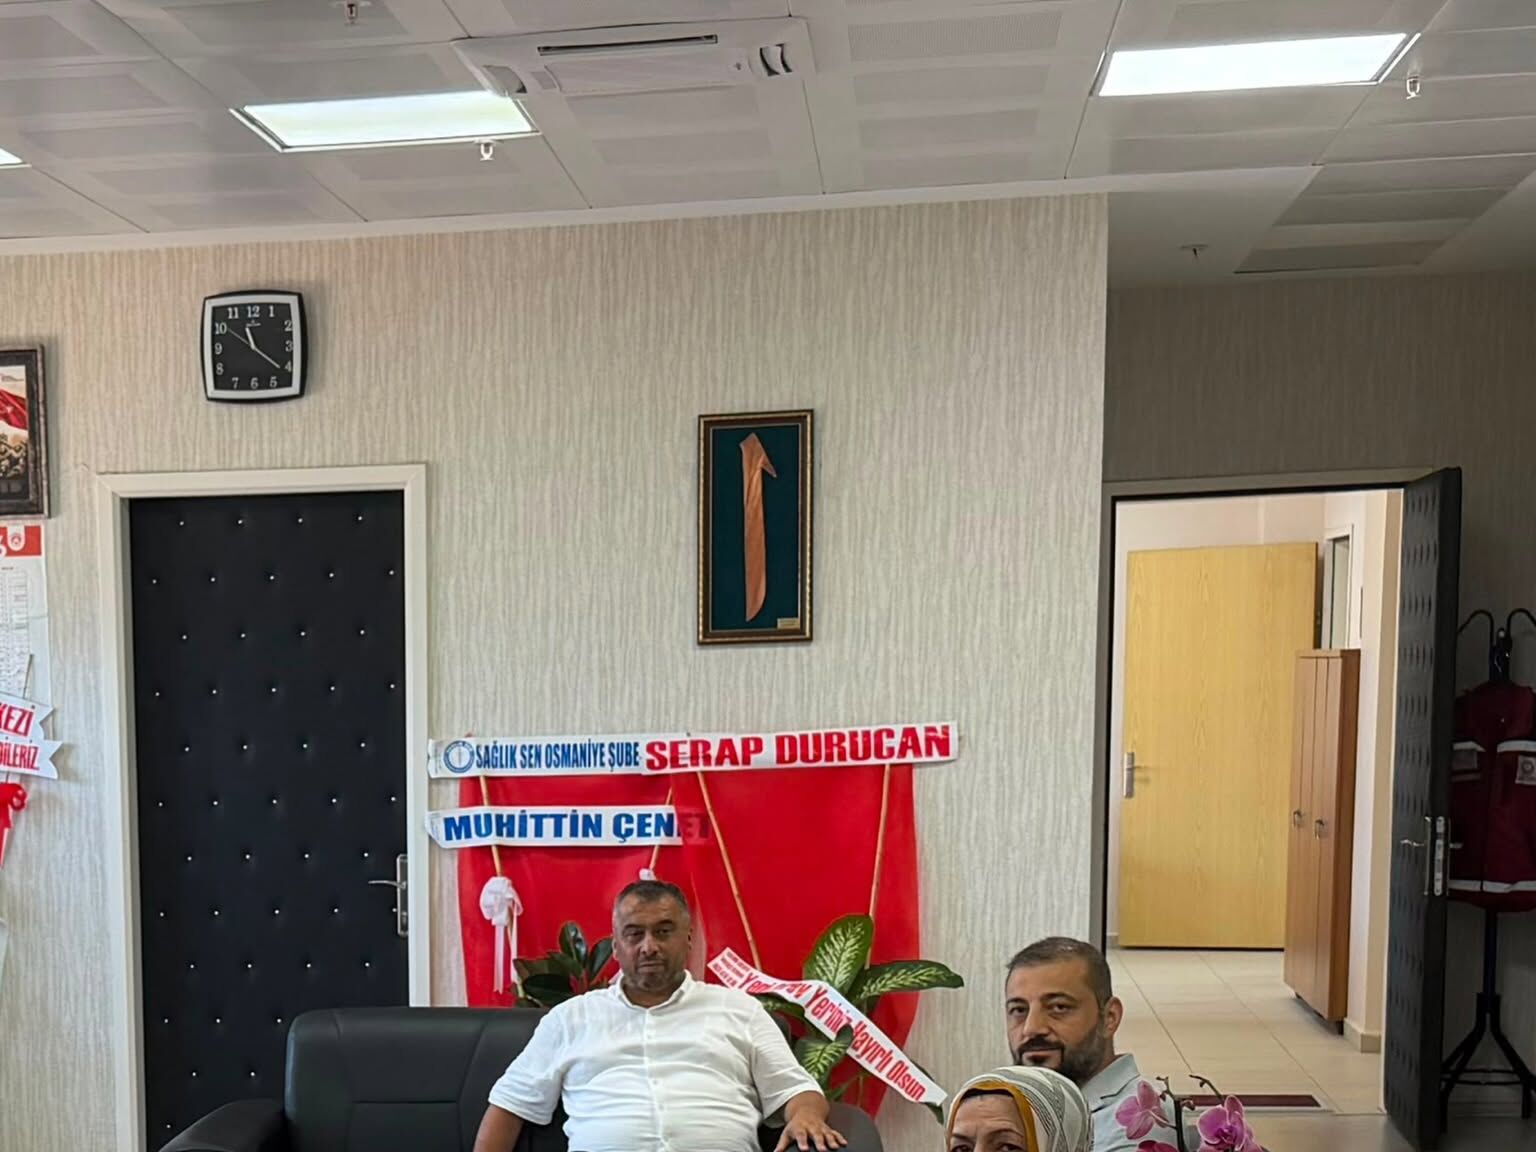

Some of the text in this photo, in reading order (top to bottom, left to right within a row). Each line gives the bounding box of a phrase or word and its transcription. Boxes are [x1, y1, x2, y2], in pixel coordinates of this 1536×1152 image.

[228, 307, 239, 319] 11
[247, 306, 260, 317] 12
[215, 322, 227, 334] 10
[476, 739, 640, 772] SAĞLIK SEN OSMANİYE ŞUBE
[646, 725, 950, 771] SERAP DURUCAN
[444, 810, 602, 841] MUHİTTİN
[851, 1021, 894, 1072] Hayırlı
[886, 1060, 926, 1101] Olsun
